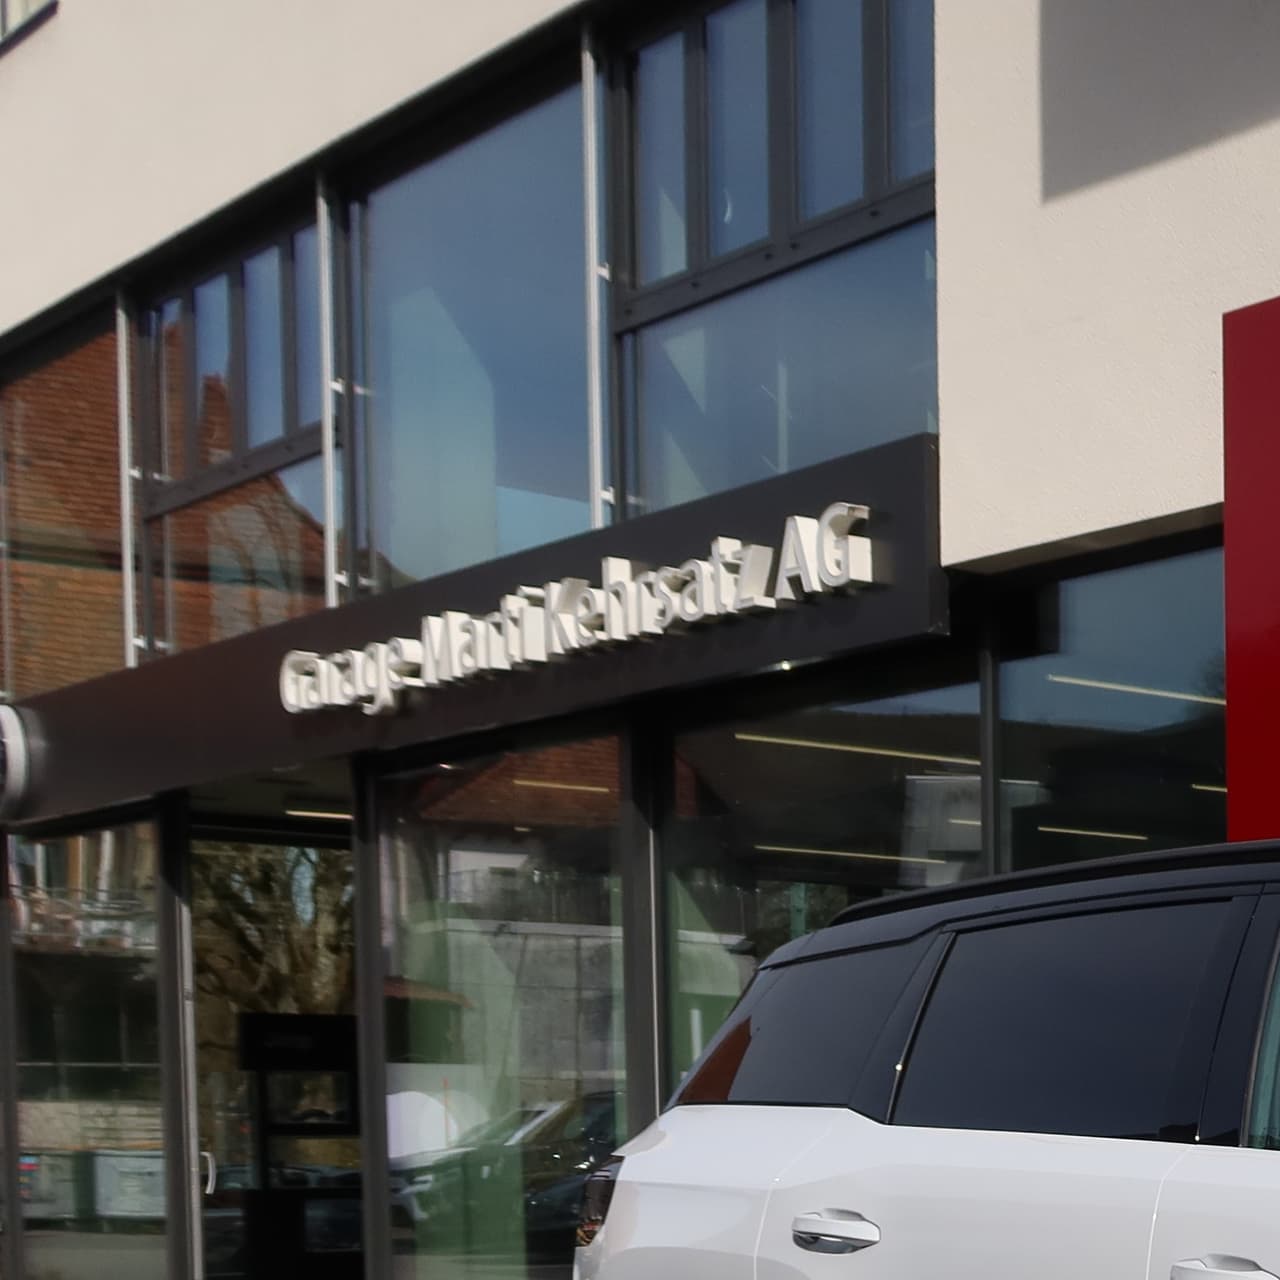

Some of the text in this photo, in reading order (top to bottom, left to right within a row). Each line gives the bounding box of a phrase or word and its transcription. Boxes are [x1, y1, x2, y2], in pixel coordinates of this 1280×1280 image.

[279, 637, 425, 716] Garage
[543, 536, 777, 655] Kehrsatz
[775, 502, 873, 600] AG
